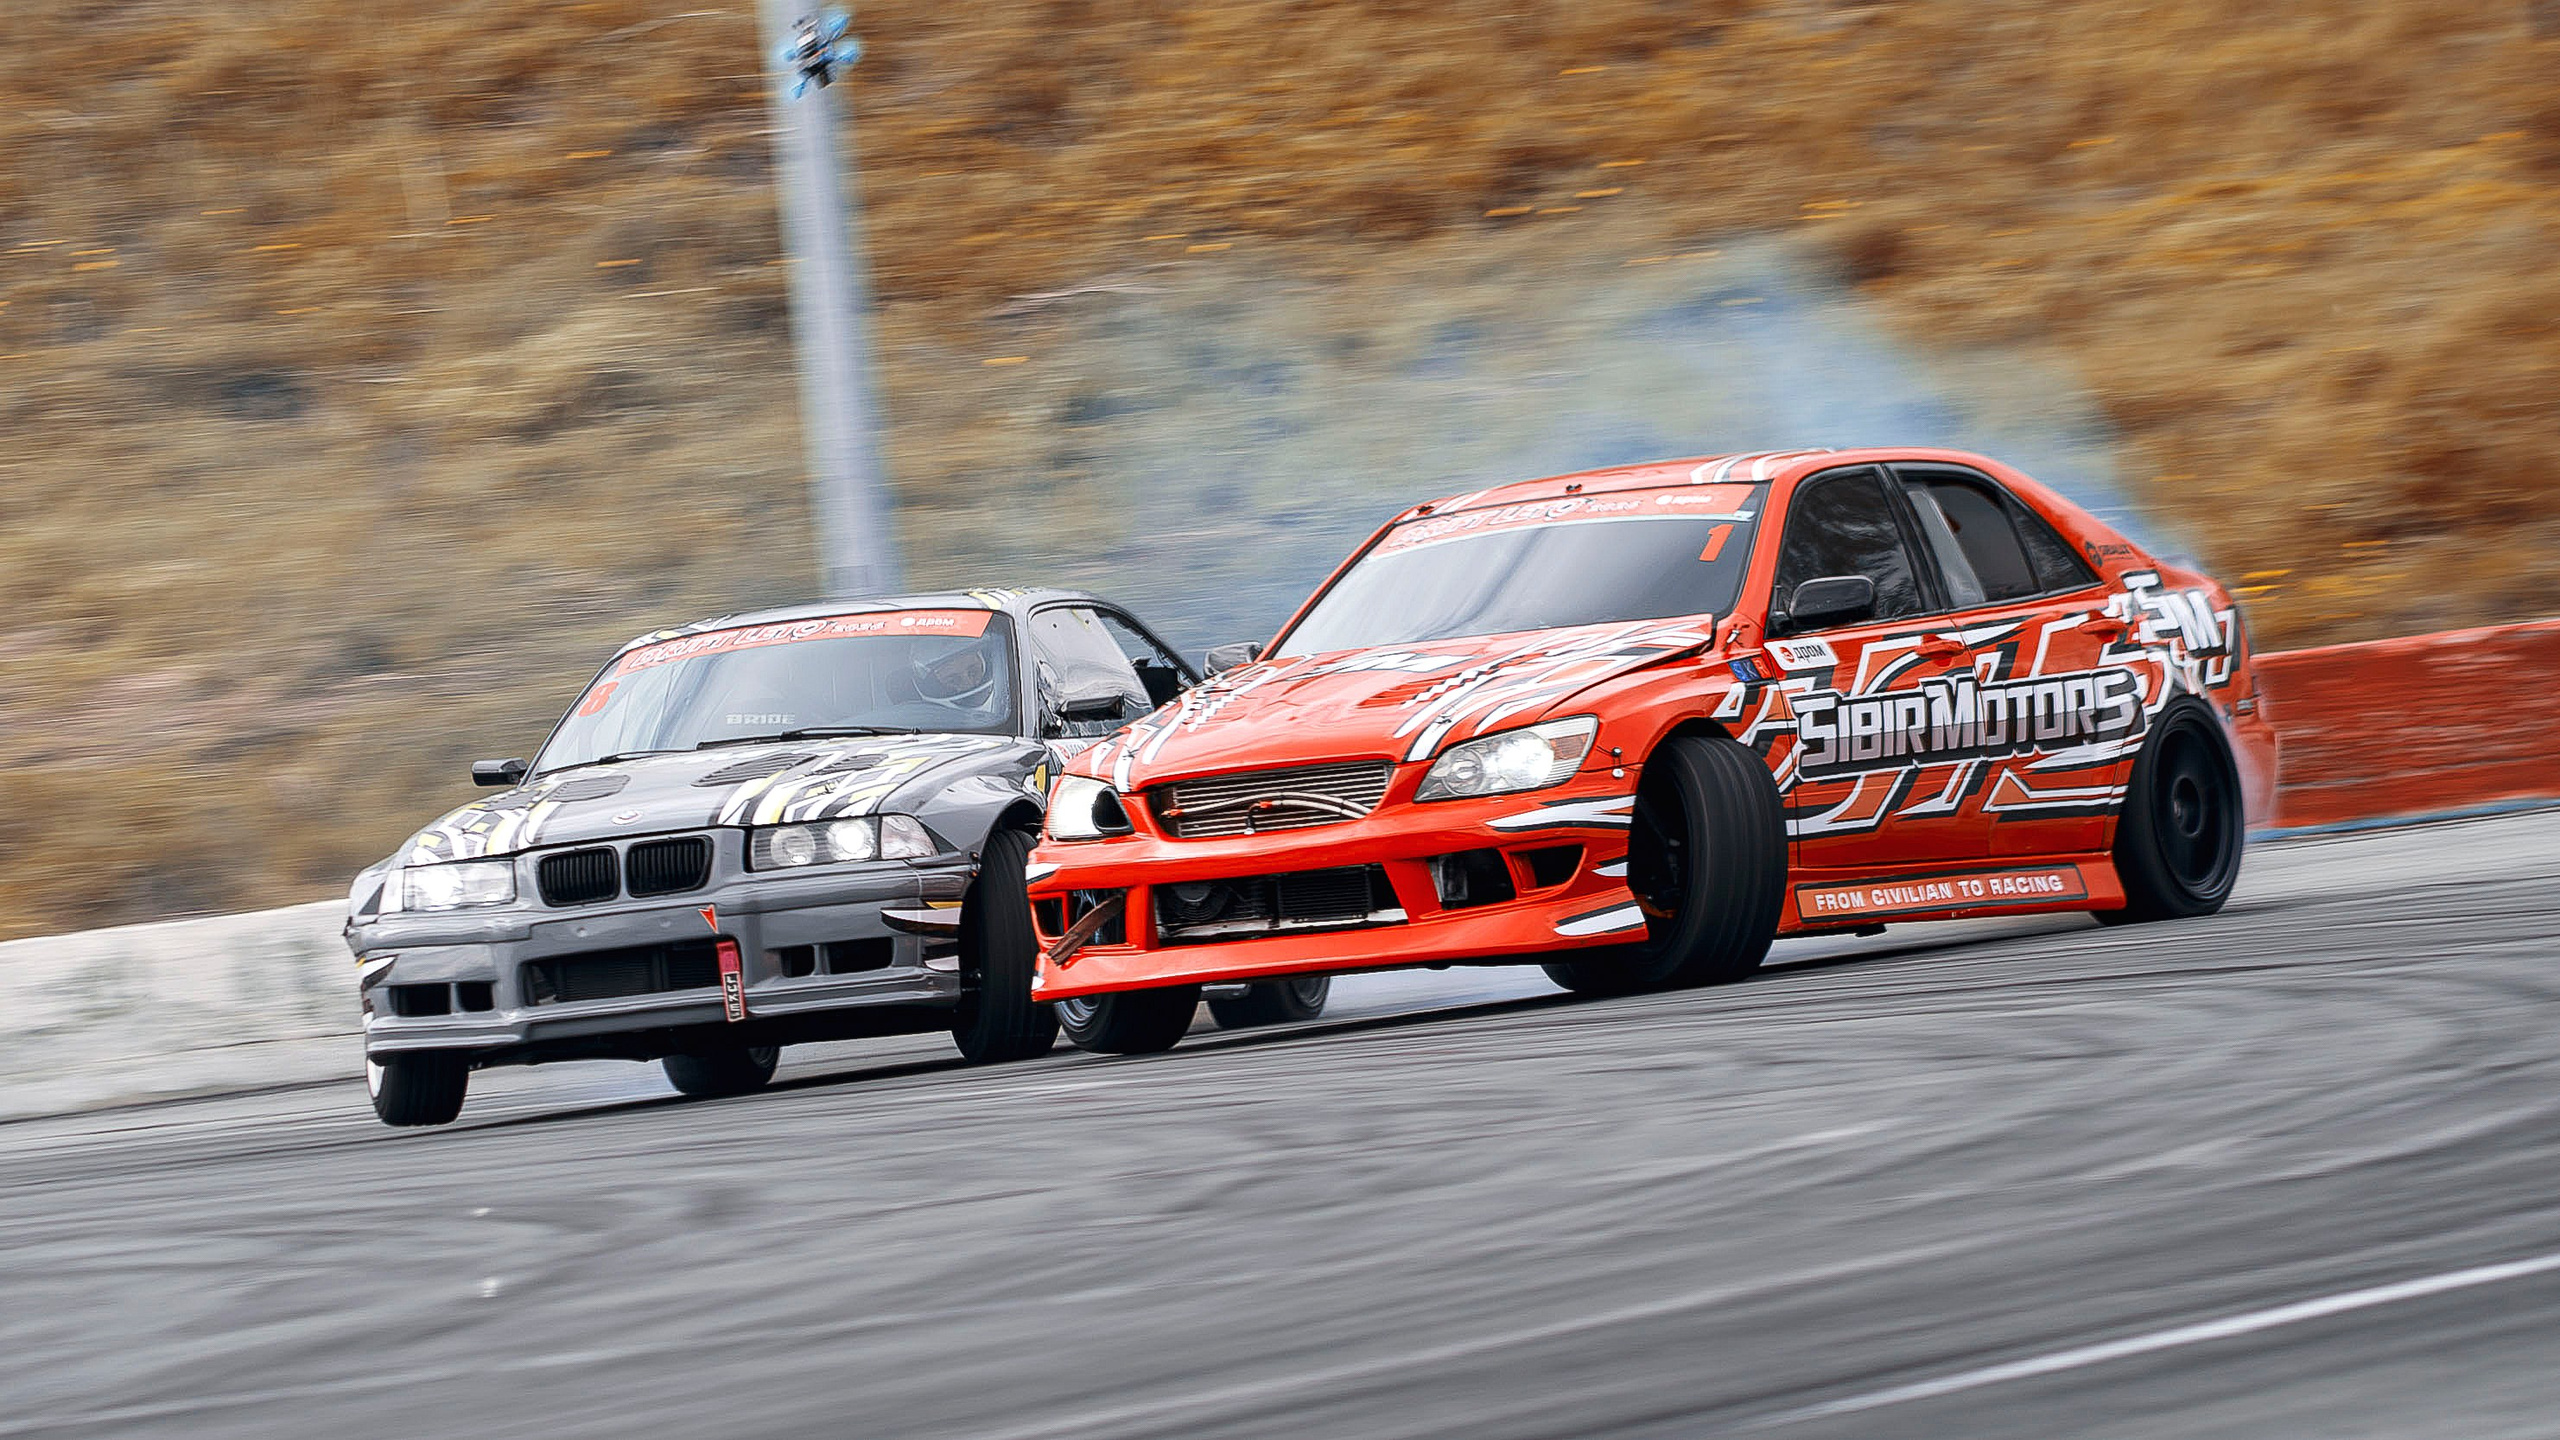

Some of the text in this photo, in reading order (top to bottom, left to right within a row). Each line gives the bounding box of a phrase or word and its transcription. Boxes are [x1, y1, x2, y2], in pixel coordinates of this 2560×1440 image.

[1699, 524, 1734, 562] 1
[578, 681, 620, 717] 8
[725, 713, 796, 725] BRIDE
[1814, 874, 2064, 911] FROM CIVILIAN TO RACING
